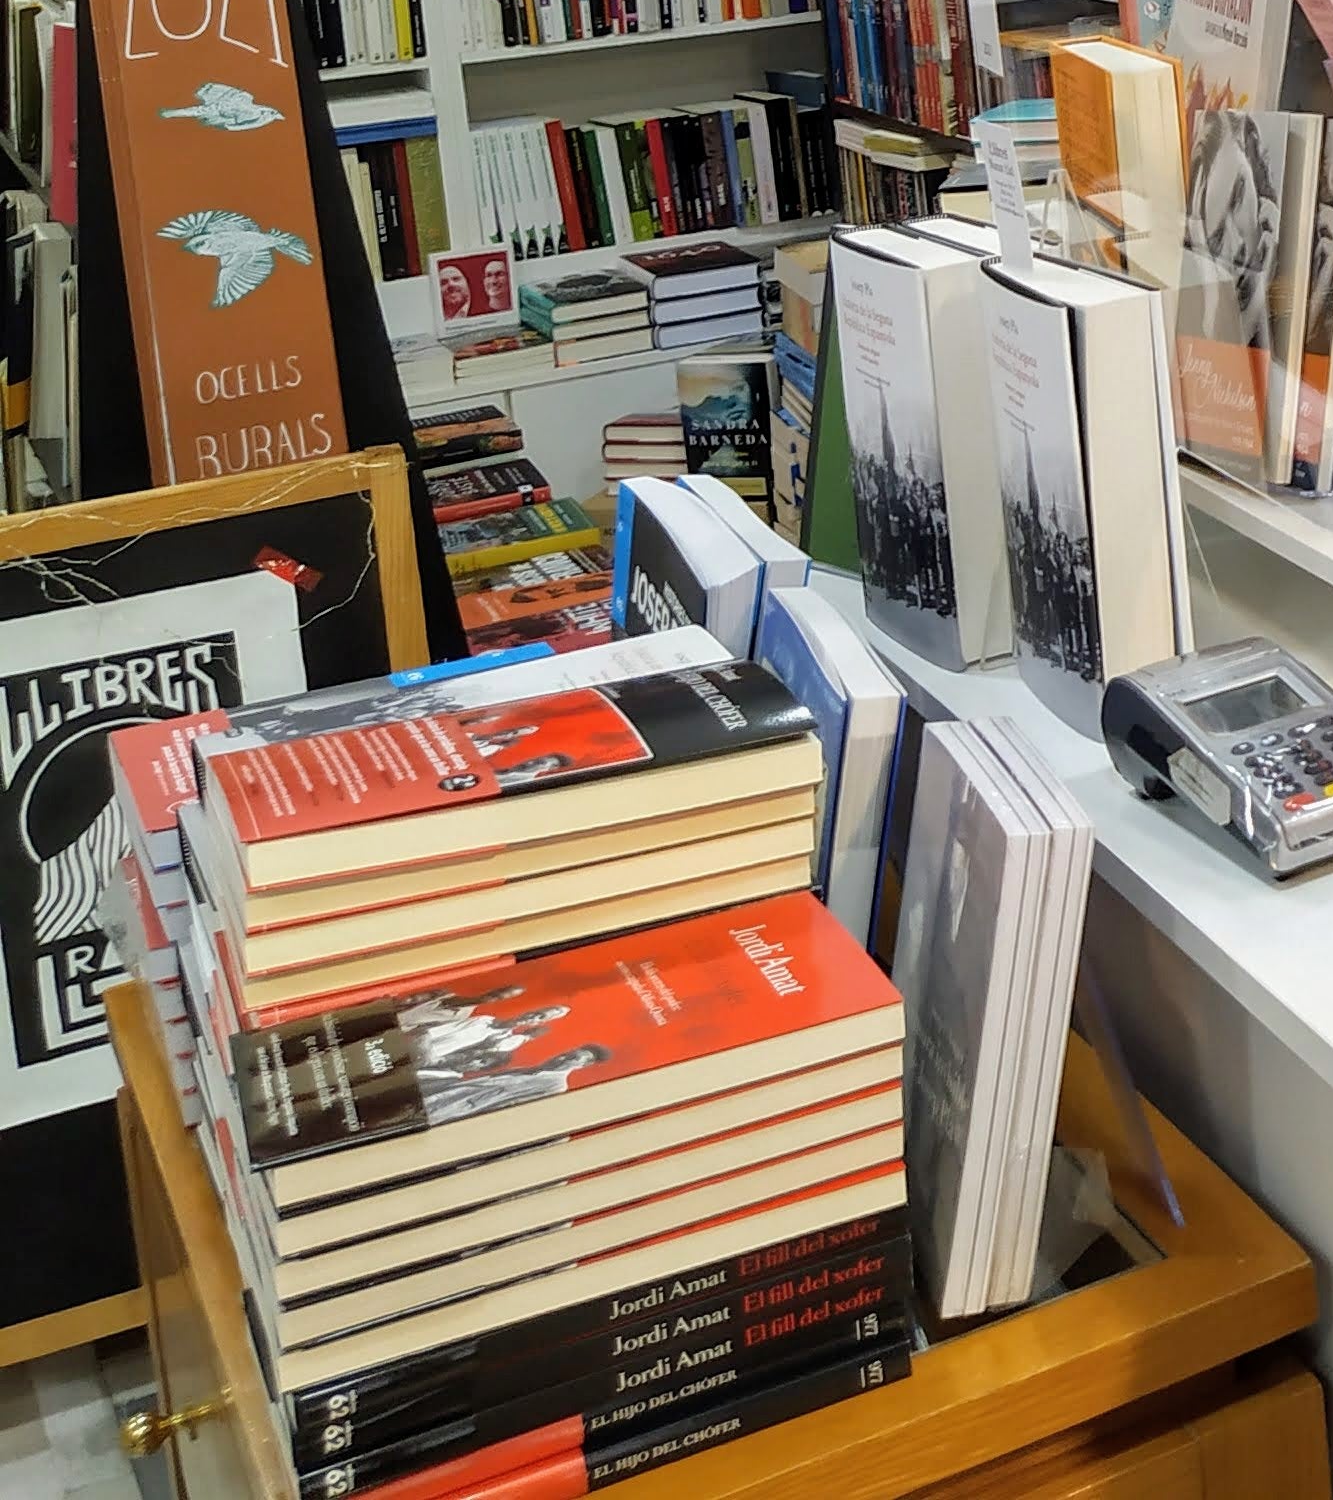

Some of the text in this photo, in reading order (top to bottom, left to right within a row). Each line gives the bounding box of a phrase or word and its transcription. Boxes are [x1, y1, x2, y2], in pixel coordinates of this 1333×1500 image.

[196, 355, 302, 404] OCELLS
[195, 413, 332, 479] RURALS
[688, 434, 768, 447] BARNEDA
[690, 418, 761, 431] SANDRA
[0, 643, 220, 791] LLIBRES
[728, 924, 807, 997] Jordi Amat
[609, 1219, 880, 1320] Jordi Amat El fill del xofer
[612, 1255, 885, 1356] Jordi Amat El fill del xofer
[615, 1285, 885, 1392] Jordi Amat El fill del xofer
[328, 1394, 350, 1420] 62
[591, 1369, 738, 1429] EL HIJO DEL CHÓFER
[323, 1425, 346, 1455] 62
[593, 1418, 741, 1479] EL HIJO DEL CHÓFER
[325, 1468, 348, 1499] 62
